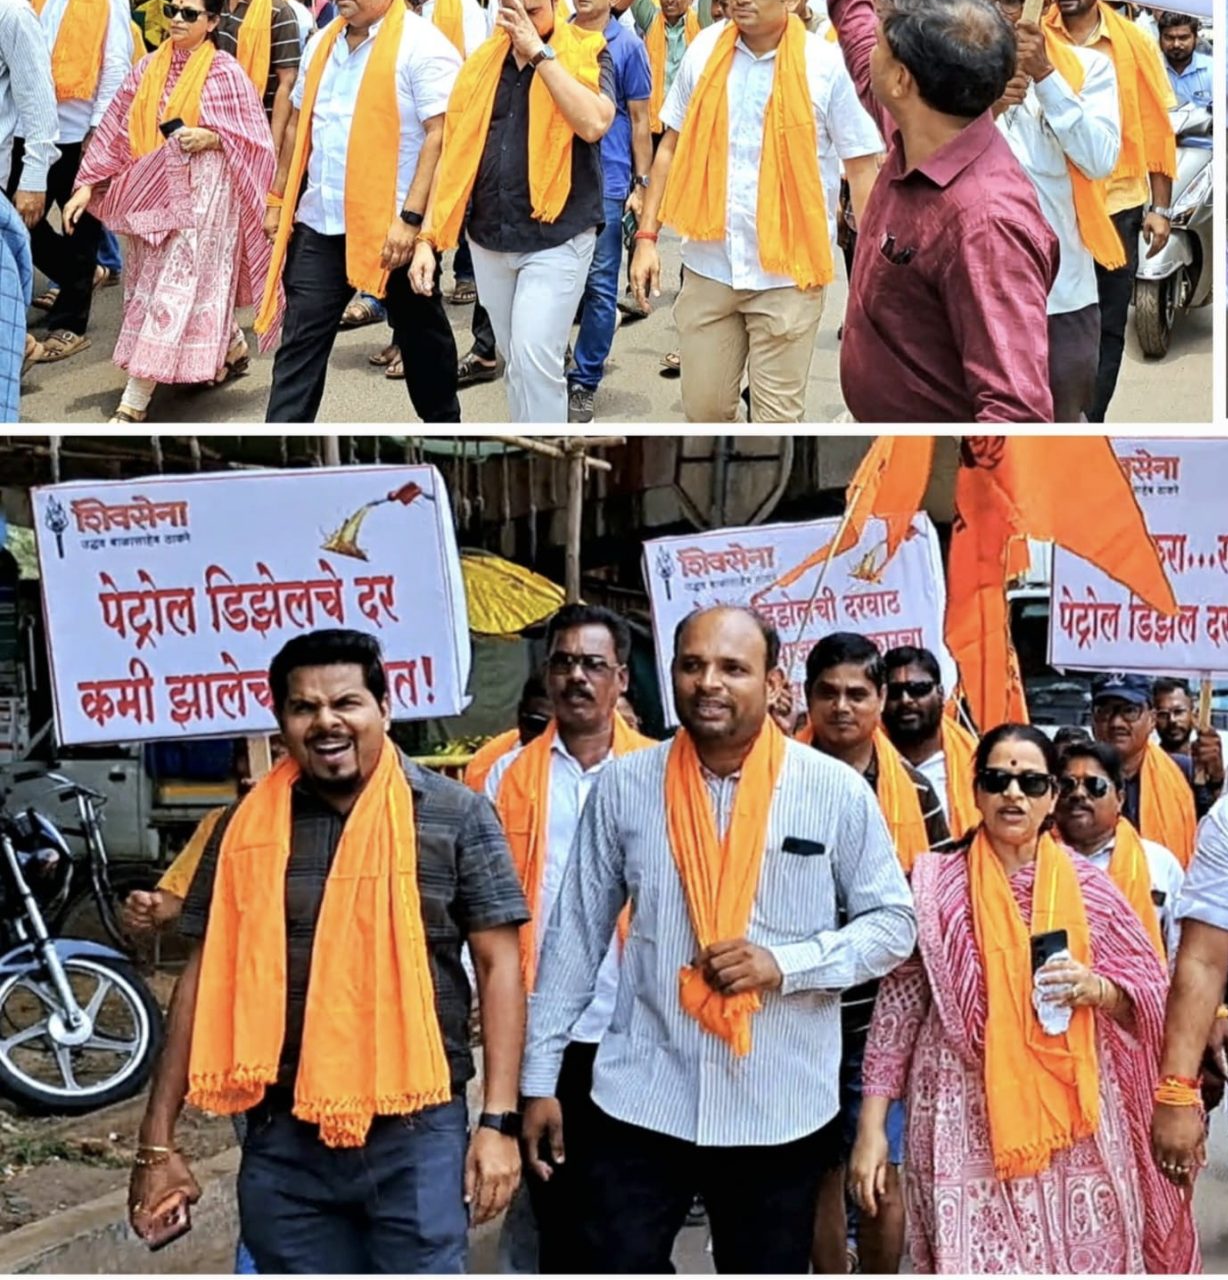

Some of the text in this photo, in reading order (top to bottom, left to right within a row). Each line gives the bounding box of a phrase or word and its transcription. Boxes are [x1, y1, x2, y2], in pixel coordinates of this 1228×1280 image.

[71, 495, 188, 535] शिवसेना
[677, 543, 774, 577] शिवसेना
[99, 559, 400, 649] पेट्रोल डिझेलचे दर
[1060, 585, 1121, 649] पेट्रोल
[78, 651, 273, 730] कमी झालेच
